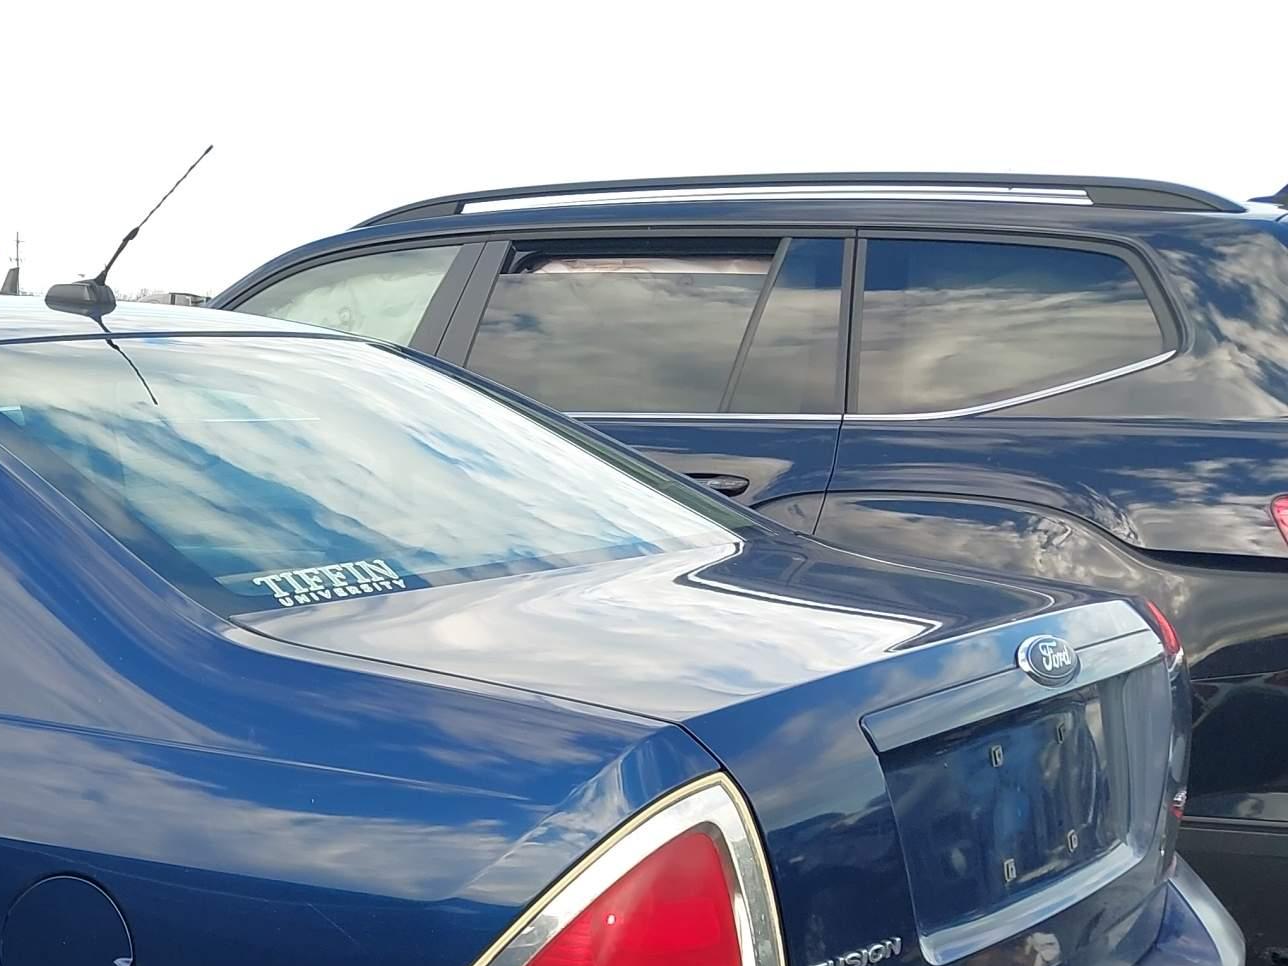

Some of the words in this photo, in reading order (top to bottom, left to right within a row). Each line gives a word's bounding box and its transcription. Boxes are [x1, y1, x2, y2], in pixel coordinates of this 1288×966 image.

[252, 559, 400, 598] TIFFIN
[278, 578, 407, 607] UNIVERSITY
[1038, 640, 1072, 671] Ford
